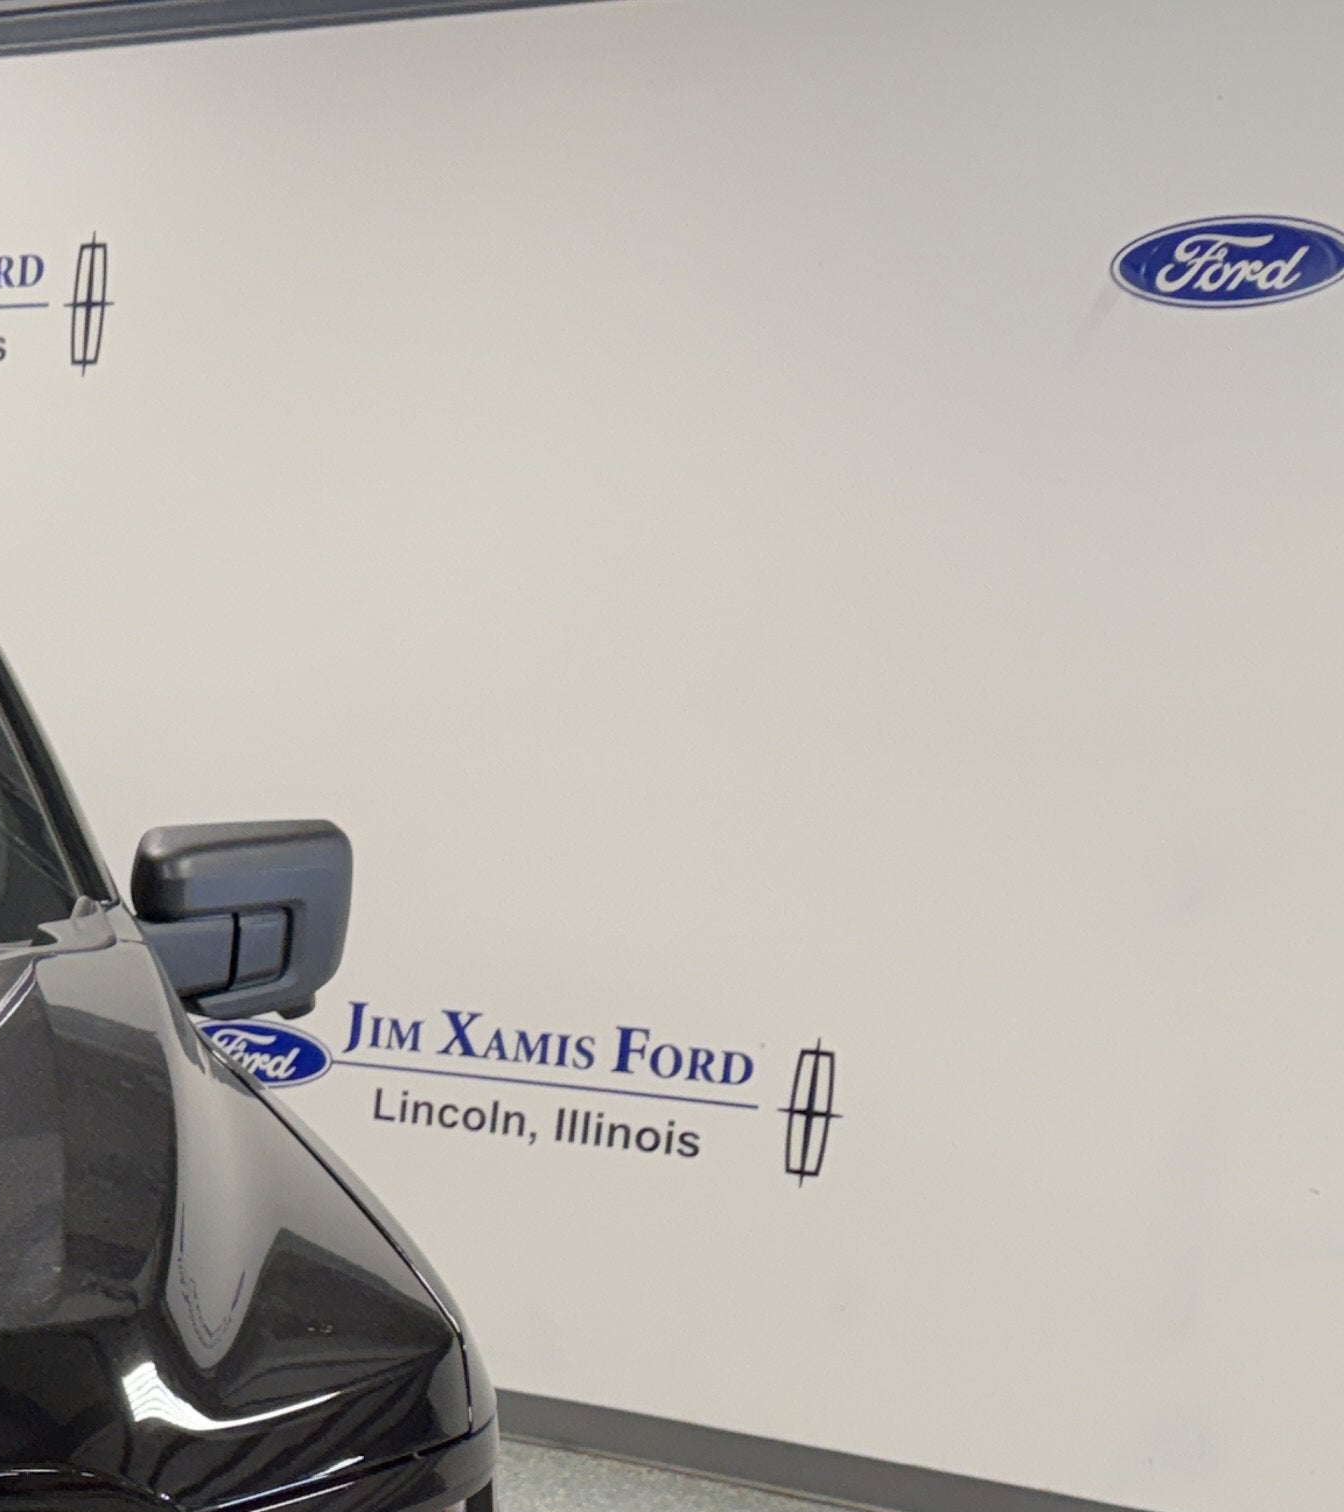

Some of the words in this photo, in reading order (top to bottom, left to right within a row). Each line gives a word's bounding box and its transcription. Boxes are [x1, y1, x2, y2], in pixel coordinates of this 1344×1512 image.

[1155, 233, 1310, 293] Ford
[341, 1000, 422, 1054] JIM
[439, 1008, 596, 1070] XAMIS
[611, 1025, 754, 1086] FORD
[373, 1087, 538, 1145] Lincoln,
[554, 1107, 701, 1159] Illinois
